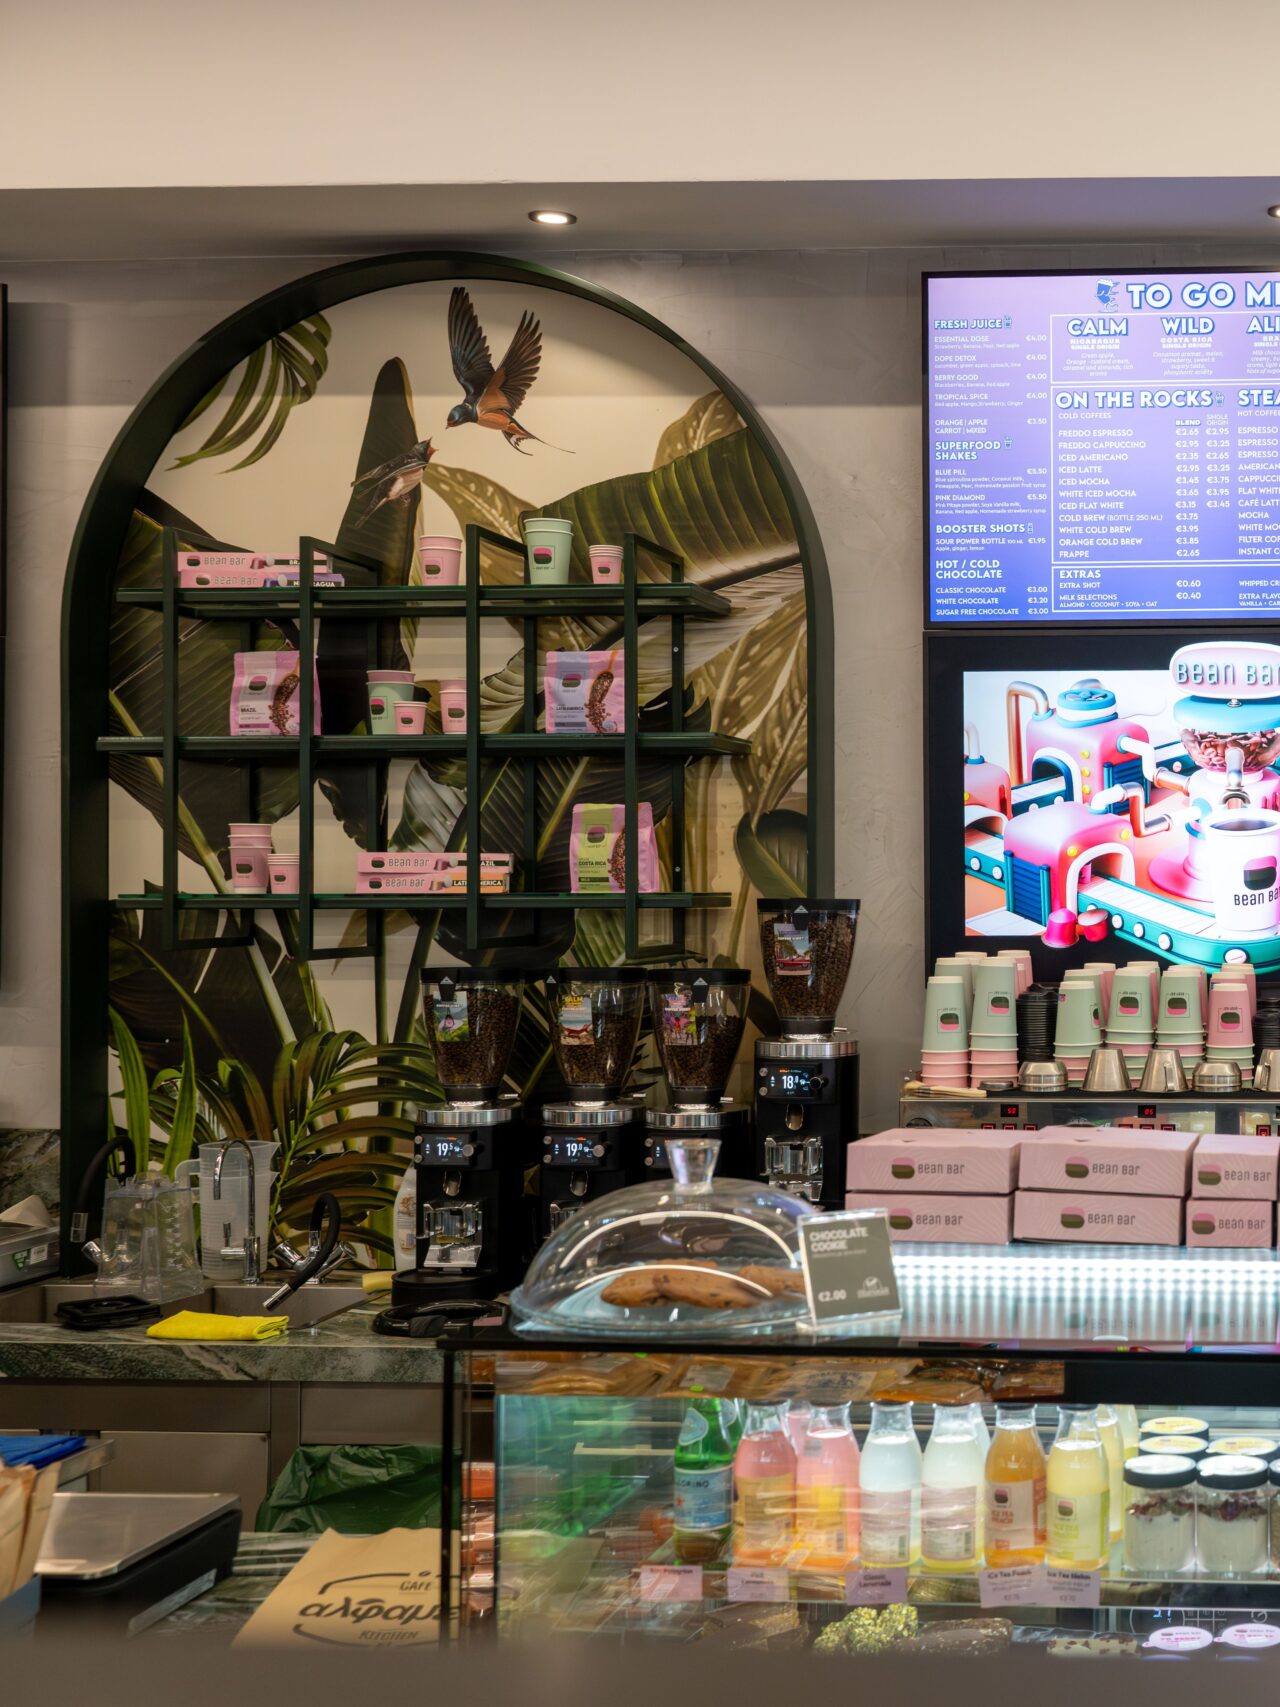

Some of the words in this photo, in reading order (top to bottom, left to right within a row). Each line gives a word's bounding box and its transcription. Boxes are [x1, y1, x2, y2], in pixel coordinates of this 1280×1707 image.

[1126, 282, 1172, 309] TO
[1181, 282, 1236, 308] GO
[934, 319, 968, 330] FRESH
[970, 319, 1002, 329] JUICE
[1067, 318, 1128, 337] CALM
[1160, 317, 1215, 335] WILD
[1055, 392, 1090, 409] ON
[1095, 392, 1134, 408] THE
[1140, 390, 1213, 408] ROCKS
[1093, 429, 1133, 437] ESPRESSO
[1238, 426, 1278, 434] ESPRESSO
[936, 441, 1000, 450] SUPERFOOD
[936, 452, 977, 460] SHAKES
[1079, 453, 1128, 461] AMERICANO
[1238, 450, 1278, 458] ESPRESSO
[937, 525, 986, 533] BOOSTER
[990, 524, 1025, 533] SHOTS
[936, 560, 958, 568] HOT
[970, 560, 1000, 568] COLD
[936, 570, 1002, 579] CHOCOLATE
[1060, 570, 1101, 578] EXTRAS
[809, 1227, 869, 1242] CHOCOLATE
[811, 1240, 847, 1252] COOKIE
[818, 1289, 847, 1302] €2.00
